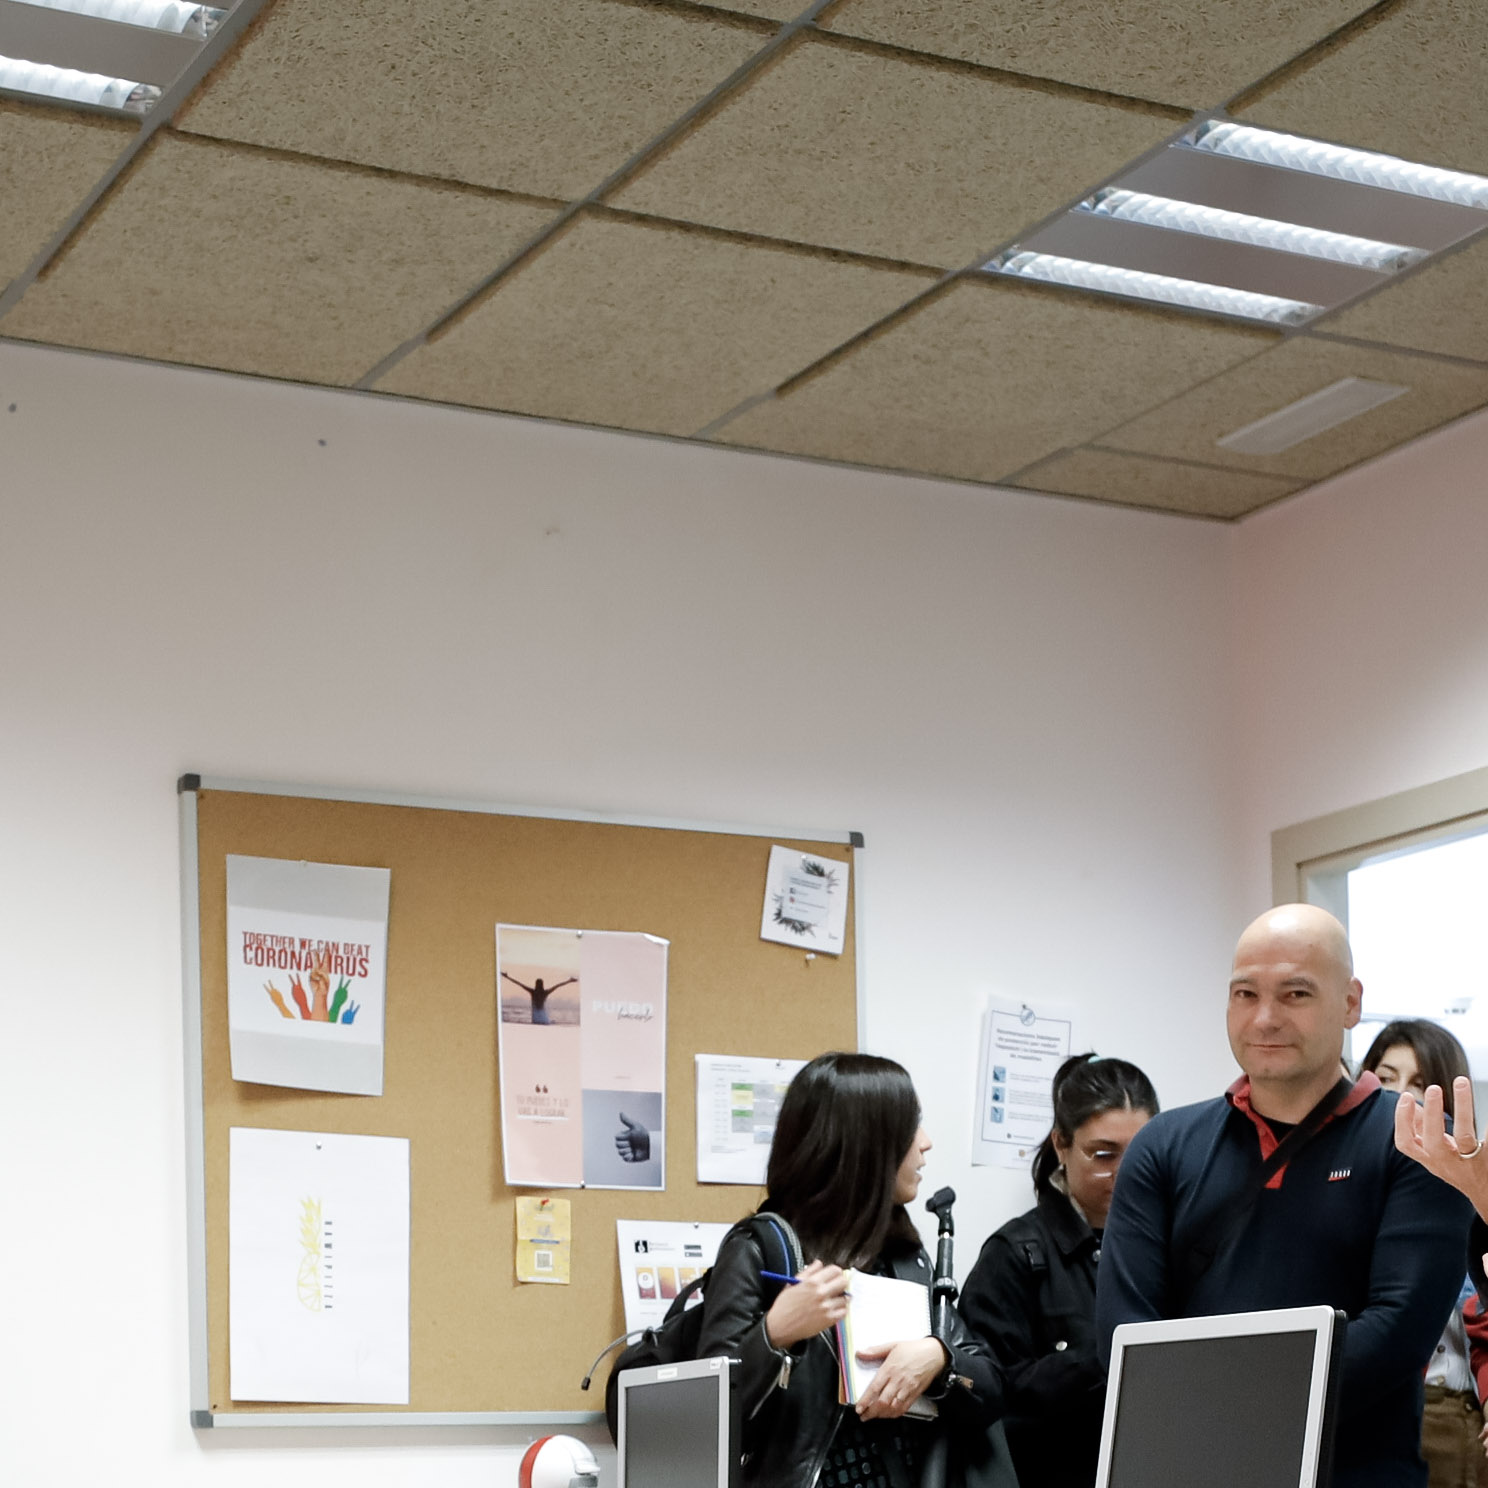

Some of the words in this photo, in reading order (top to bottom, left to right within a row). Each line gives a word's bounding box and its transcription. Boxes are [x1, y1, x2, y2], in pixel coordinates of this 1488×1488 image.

[242, 931, 295, 951] TOGETHER
[299, 938, 313, 952] WE
[317, 940, 339, 955] CAN
[243, 943, 369, 978] CORONAVIRUS
